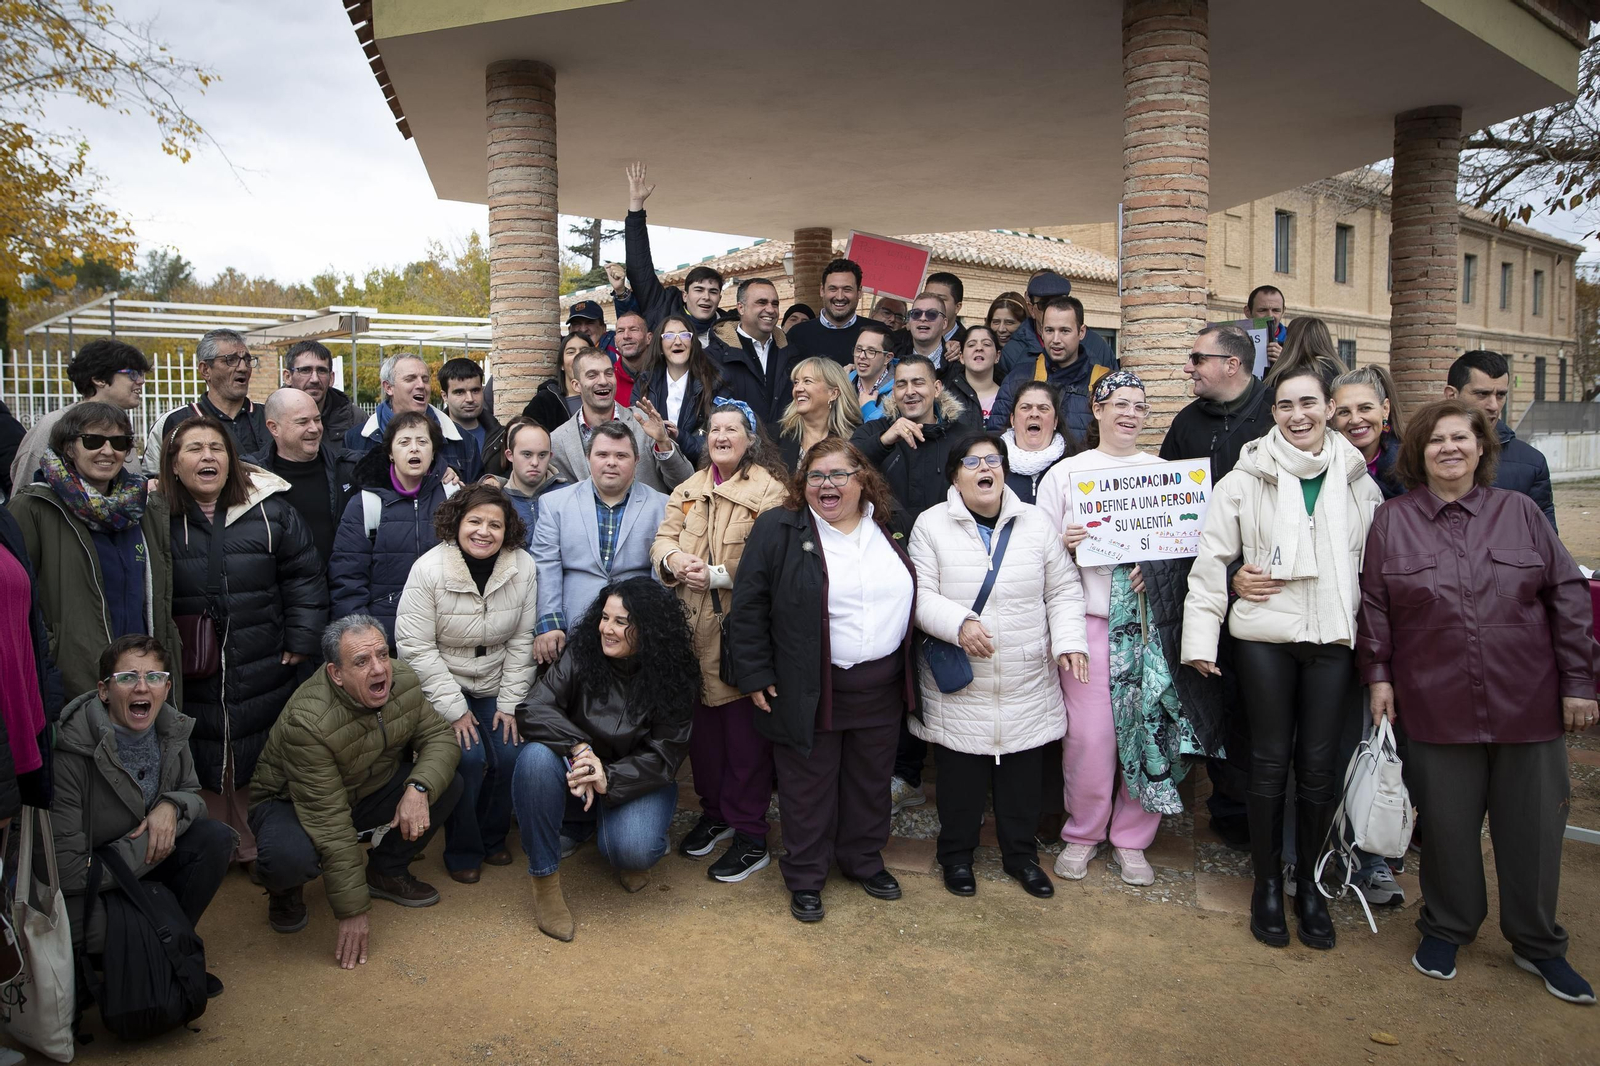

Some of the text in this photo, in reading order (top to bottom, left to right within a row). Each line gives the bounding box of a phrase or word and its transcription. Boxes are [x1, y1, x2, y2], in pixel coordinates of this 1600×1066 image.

[1099, 472, 1182, 492] LA DISCAPACIDAD
[1079, 491, 1206, 515] NO DEFINE A UNA PERSONA
[1115, 511, 1173, 532] SU VALENTÍA
[1140, 534, 1150, 551] SÍ
[1271, 545, 1282, 566] A
